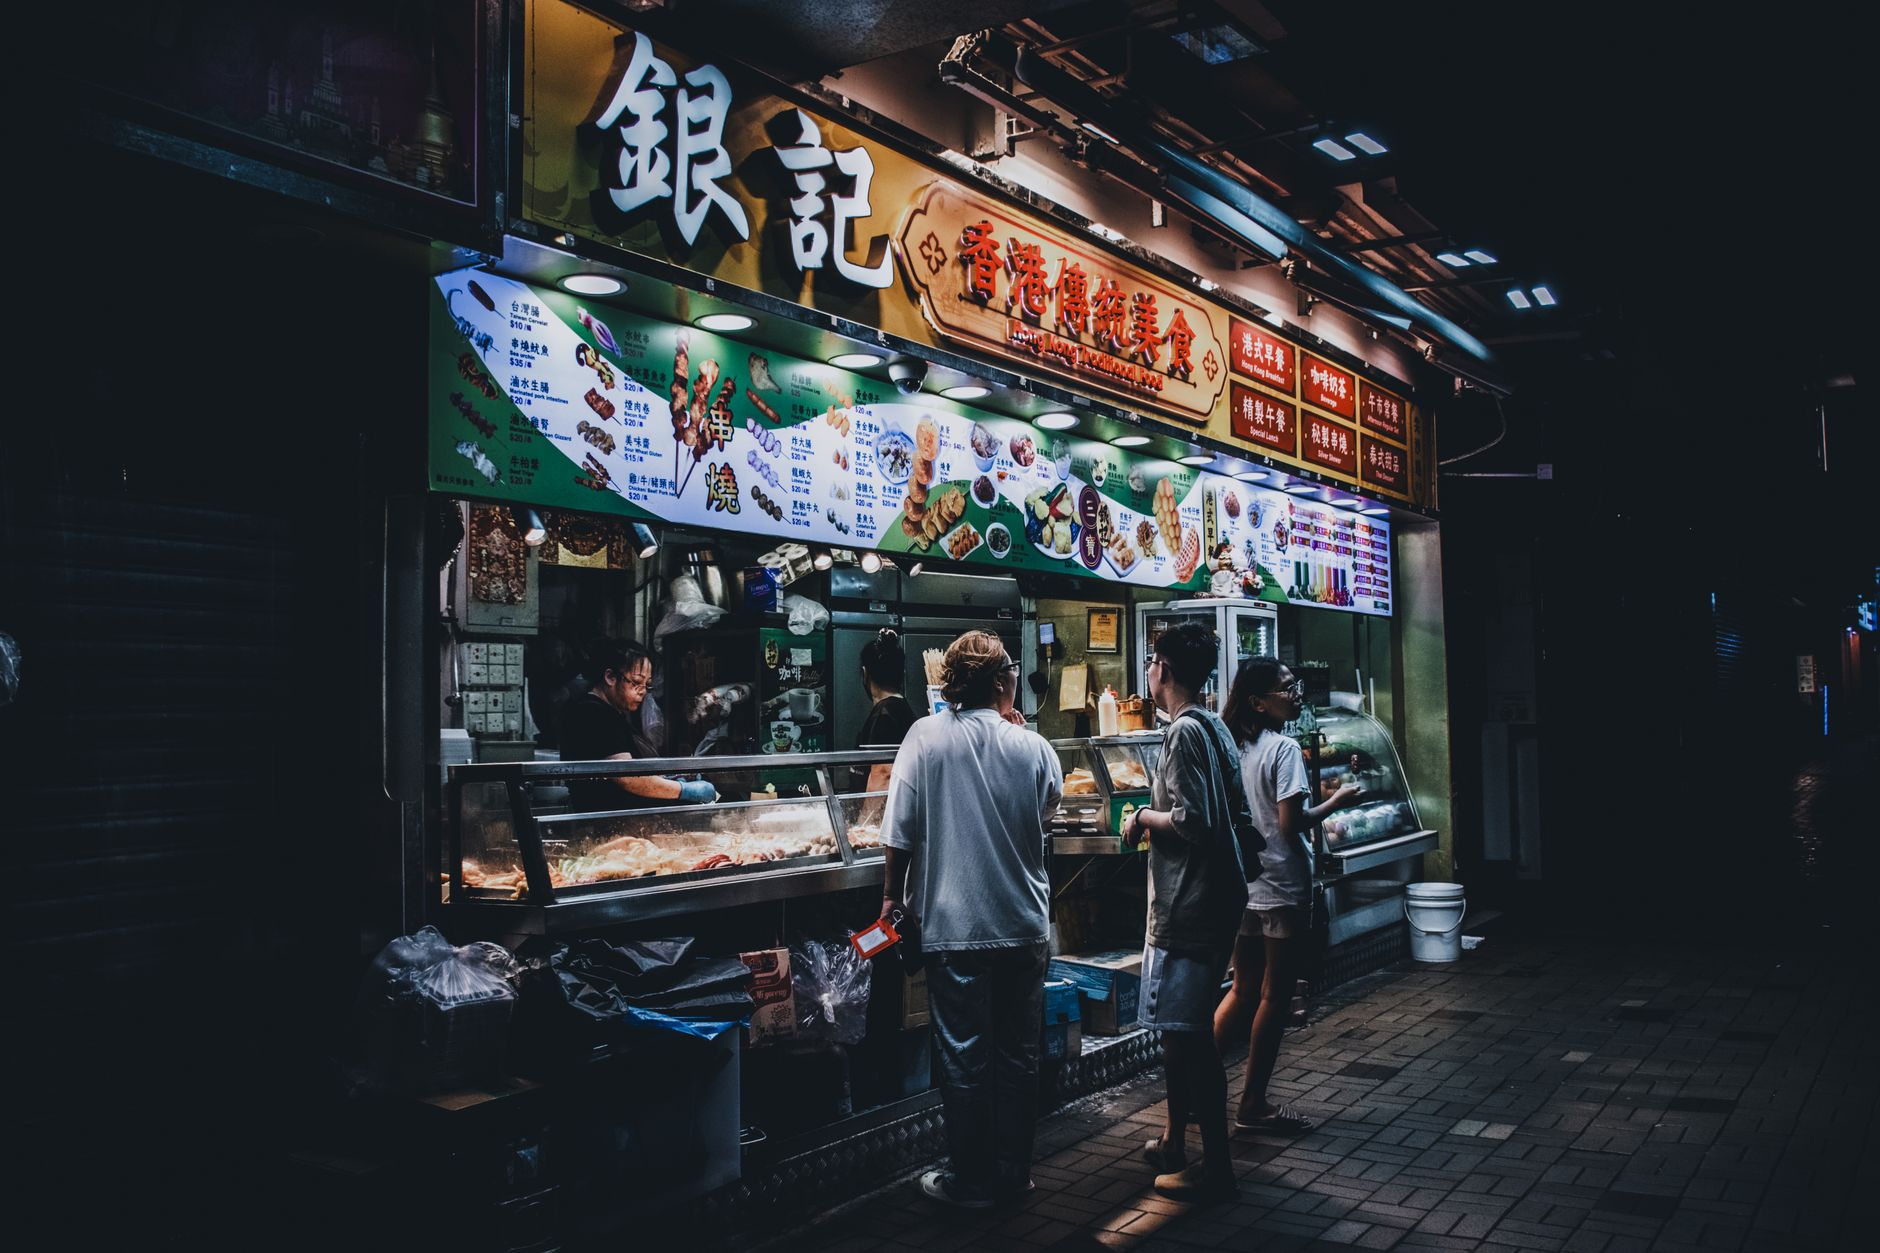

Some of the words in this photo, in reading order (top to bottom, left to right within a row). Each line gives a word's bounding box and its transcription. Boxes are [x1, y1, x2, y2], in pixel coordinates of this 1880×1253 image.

[596, 30, 894, 289] 銀記
[511, 301, 540, 318] 台灣腸
[958, 220, 1197, 375] 香港傳統美食
[510, 313, 527, 322] Taiwan
[520, 353, 535, 361] urchin
[1007, 320, 1044, 353] Hong
[1044, 334, 1077, 365] Kong
[1077, 346, 1136, 384] Traditional
[1140, 369, 1162, 391] Food
[1242, 332, 1285, 372] 港式早餐
[1241, 360, 1253, 373] Hong
[1254, 364, 1265, 378] Kong
[1266, 370, 1285, 384] Breakfast
[1311, 365, 1347, 400] 咖啡奶茶
[510, 388, 533, 397] Marinated
[534, 393, 545, 401] pork
[546, 395, 568, 404] intestines
[1243, 395, 1285, 433] 精製午餐
[1249, 426, 1267, 441] Special
[1267, 431, 1279, 443] Lunch
[1311, 422, 1348, 455] 秘製串燒
[649, 450, 663, 458] Gluten
[779, 666, 801, 683] 咖啡
